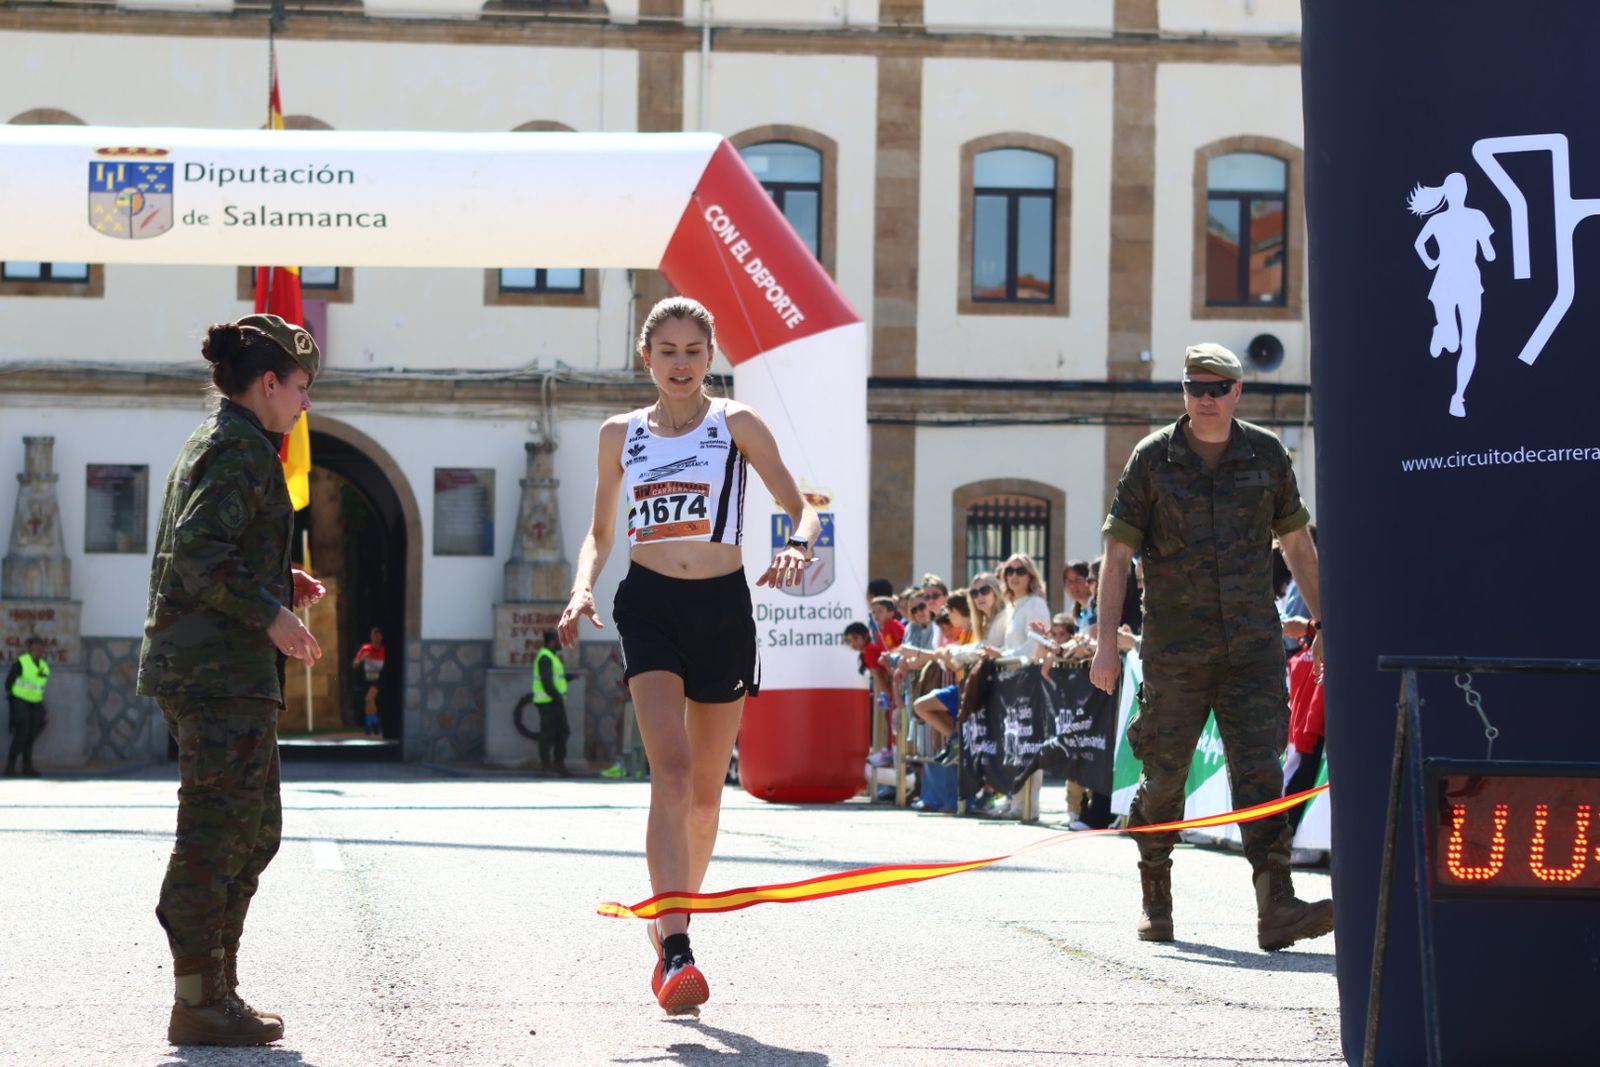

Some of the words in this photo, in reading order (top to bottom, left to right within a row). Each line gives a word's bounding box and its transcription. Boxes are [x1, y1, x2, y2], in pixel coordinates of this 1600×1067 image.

[184, 162, 355, 187] Diputación
[182, 209, 209, 226] de
[223, 205, 387, 228] Salamanca
[704, 204, 740, 245] CON
[729, 238, 752, 264] EL
[744, 257, 805, 329] DEPORTE
[1401, 446, 1600, 472] www.circuitodecarrera
[639, 494, 707, 526] 1674
[757, 602, 852, 625] Diputación
[768, 629, 848, 648] Salaman
